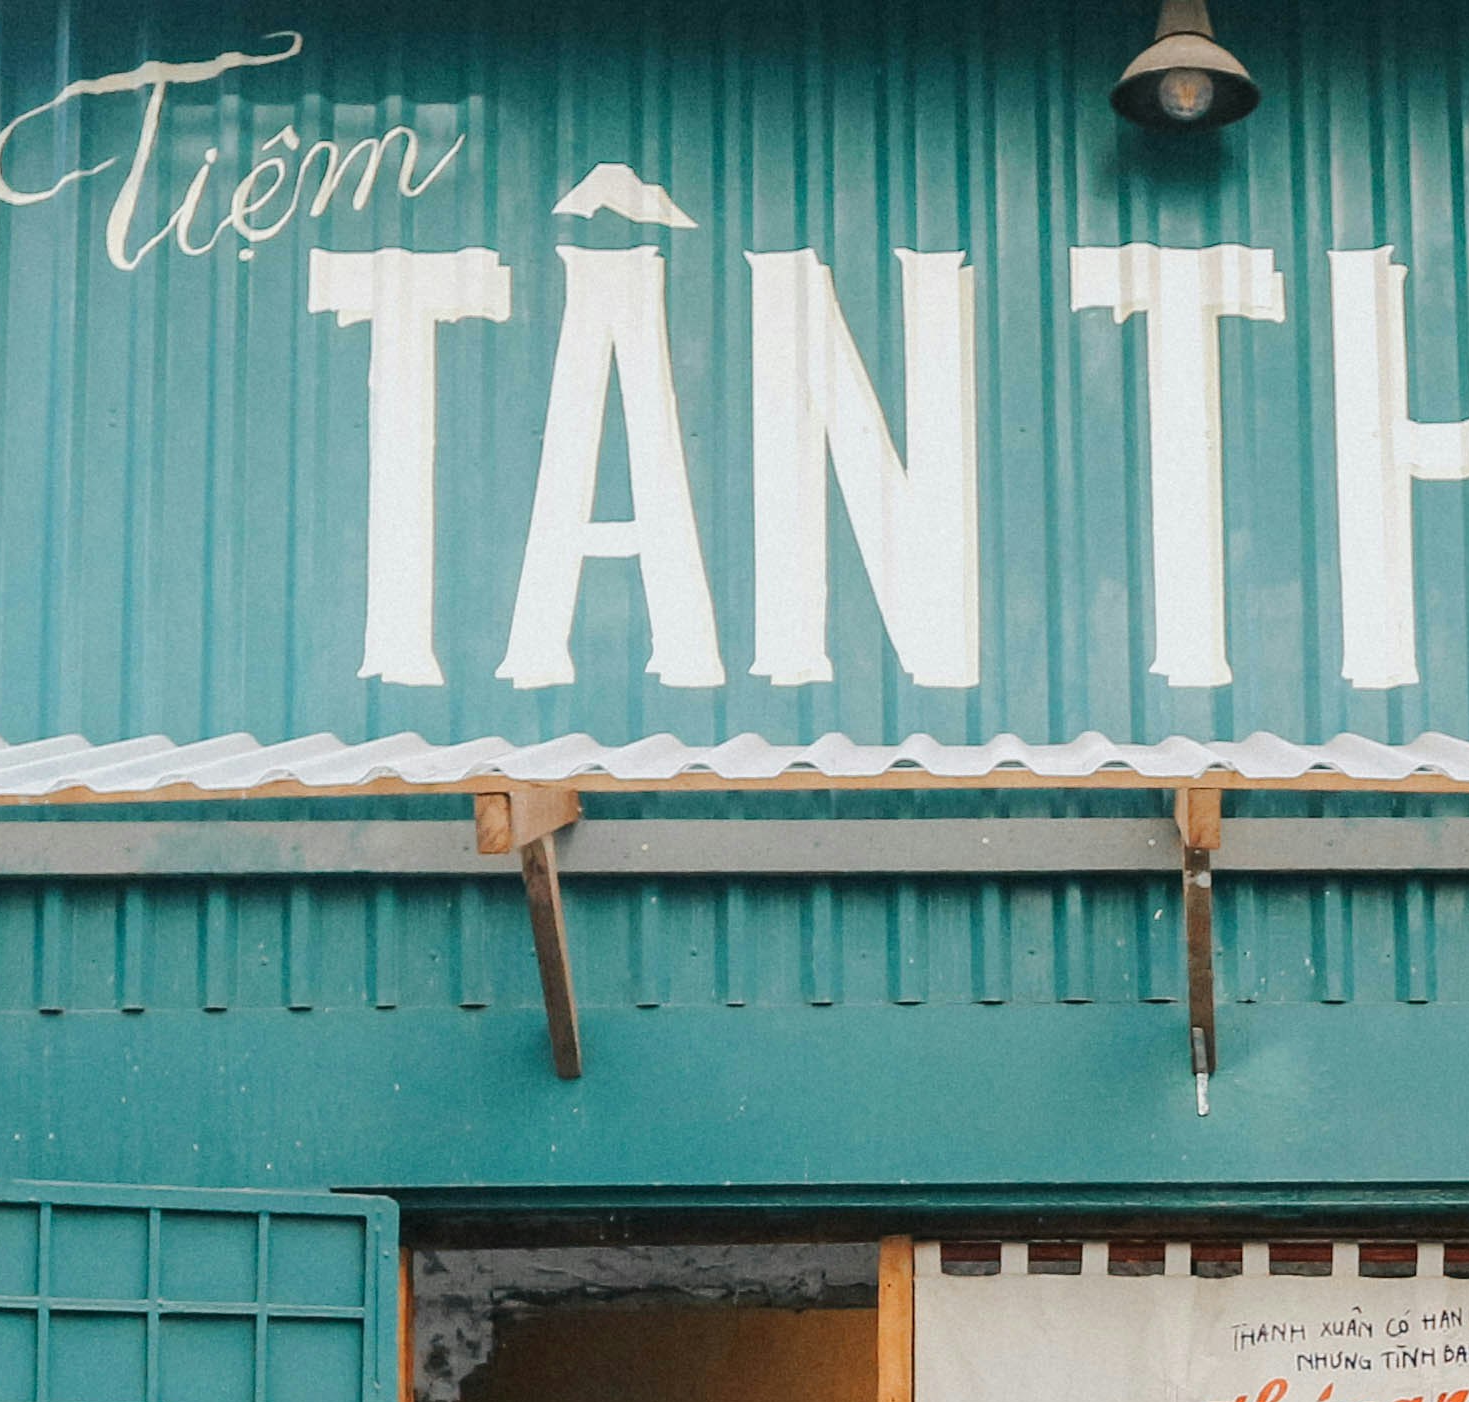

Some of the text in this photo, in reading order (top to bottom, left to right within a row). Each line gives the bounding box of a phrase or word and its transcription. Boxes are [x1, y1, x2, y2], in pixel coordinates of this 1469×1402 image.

[308, 161, 980, 689] TÂN
[1231, 1322, 1307, 1352] THANH
[1320, 1305, 1374, 1339] XUÂN
[1386, 1309, 1412, 1338] CÓ
